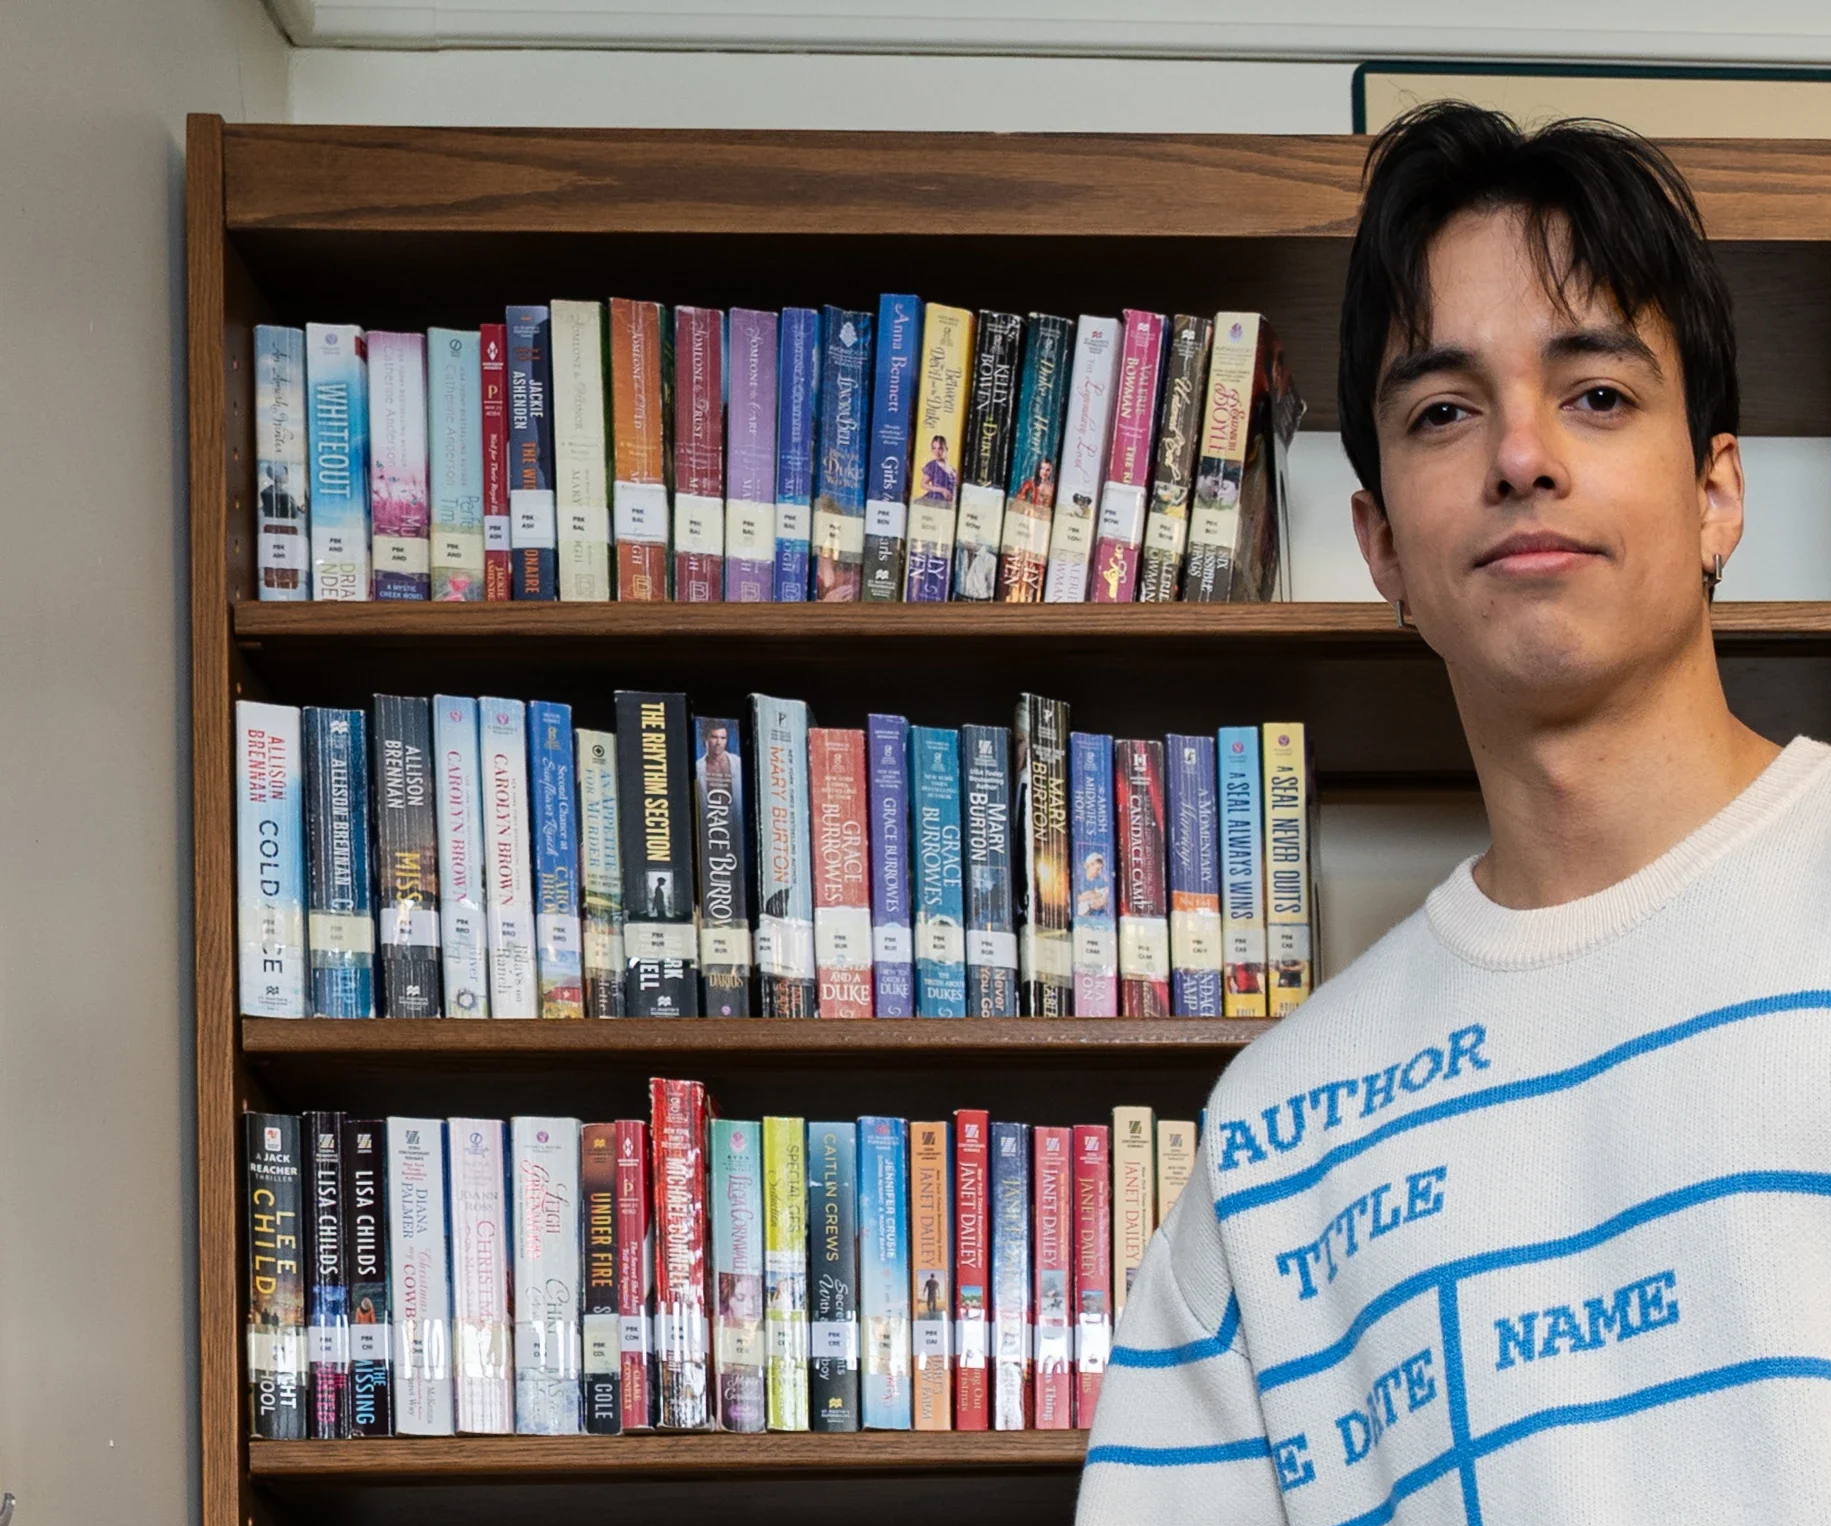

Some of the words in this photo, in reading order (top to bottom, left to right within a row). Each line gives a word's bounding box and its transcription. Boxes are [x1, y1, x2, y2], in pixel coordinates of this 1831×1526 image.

[892, 303, 908, 349] Anna
[512, 371, 526, 429] ASHENDEN
[529, 380, 543, 417] JACKIE
[887, 356, 907, 413] Bennett
[978, 354, 994, 410] BOWEN
[1121, 357, 1136, 417] BOWMAN
[317, 384, 351, 499] WHITEOUT
[641, 703, 665, 730] THE
[384, 739, 404, 808] BRENNAN
[406, 745, 424, 806] ALLISON
[643, 732, 667, 790] RHYTHM
[770, 746, 786, 801] MARY
[1272, 776, 1298, 809] SEAL
[645, 793, 670, 861] SECTION
[772, 806, 789, 884] BURTON
[921, 807, 941, 905] BURROWES
[942, 824, 961, 887] GRACE
[969, 793, 987, 861] BURTON
[990, 803, 1006, 854] MARY
[1271, 819, 1299, 862] NEVER
[259, 820, 279, 897] COLD
[1273, 870, 1300, 913] QUITS
[1217, 1023, 1492, 1172] AUTHOR
[356, 1170, 374, 1208] LISA
[824, 1134, 837, 1197] CAITLIN
[960, 1162, 976, 1213] JANET
[253, 1189, 276, 1295] CHILD
[276, 1211, 297, 1274] LEE
[358, 1215, 376, 1275] CHILDS
[591, 1192, 611, 1245] UNDER
[825, 1203, 838, 1261] CREWS
[961, 1218, 976, 1268] DAILEY
[1275, 1166, 1447, 1301] TITLE
[592, 1254, 612, 1287] FIRE
[1494, 1268, 1681, 1370] NAME
[595, 1383, 613, 1419] COLE
